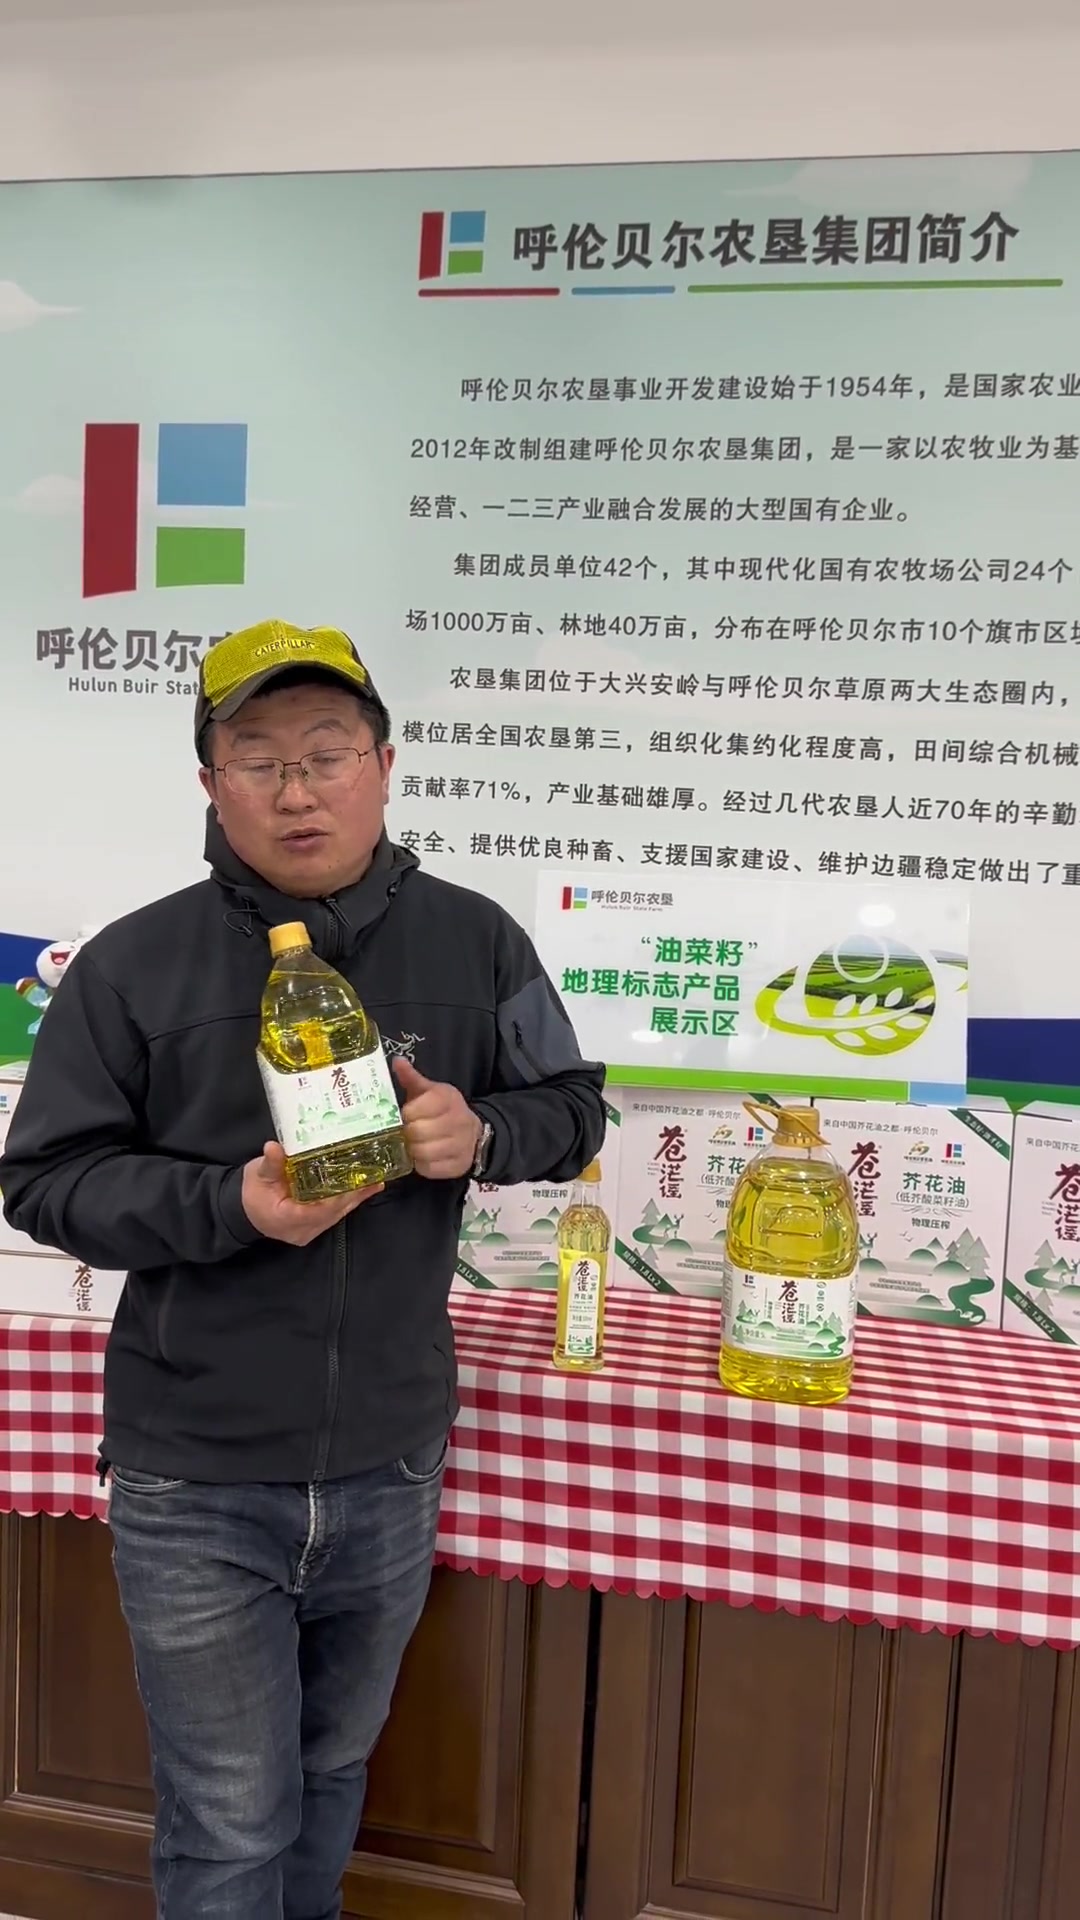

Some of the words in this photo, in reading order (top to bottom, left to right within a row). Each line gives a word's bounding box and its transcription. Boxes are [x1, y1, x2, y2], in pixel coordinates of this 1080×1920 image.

[513, 210, 1020, 272] 呼伦贝尔农垦集团简介
[460, 371, 1080, 402] 呼伦贝尔农垦事业开发建设始于1954年，是国家农业
[410, 434, 1080, 462] 2012年改制组建呼伦贝尔农垦集团，是一家以农牧业为基
[409, 494, 908, 523] 经营、一二三产业融合发展的大型国有企业。
[453, 552, 1074, 584] 集团成员单位42个，其中现代化国有农牧场公司24个
[68, 676, 118, 693] Hulun
[123, 678, 159, 694] Buir
[165, 679, 200, 695] Stat
[449, 665, 1068, 708] 农垦集团位于大兴安岭与呼伦贝尔草原两大生态圈内，
[401, 719, 1080, 767] 模位居全国农垦第三，组织化集约化程度高，田间综合机械
[591, 890, 674, 906] 呼伦贝尔农垦
[641, 936, 758, 967] “油菜籽”
[561, 967, 740, 1001] 地理标志产品
[650, 1006, 740, 1036] 展示区
[532, 1188, 568, 1199] 物理压榨
[902, 1171, 966, 1195] 芥花油
[911, 1217, 951, 1230] 物理压榨
